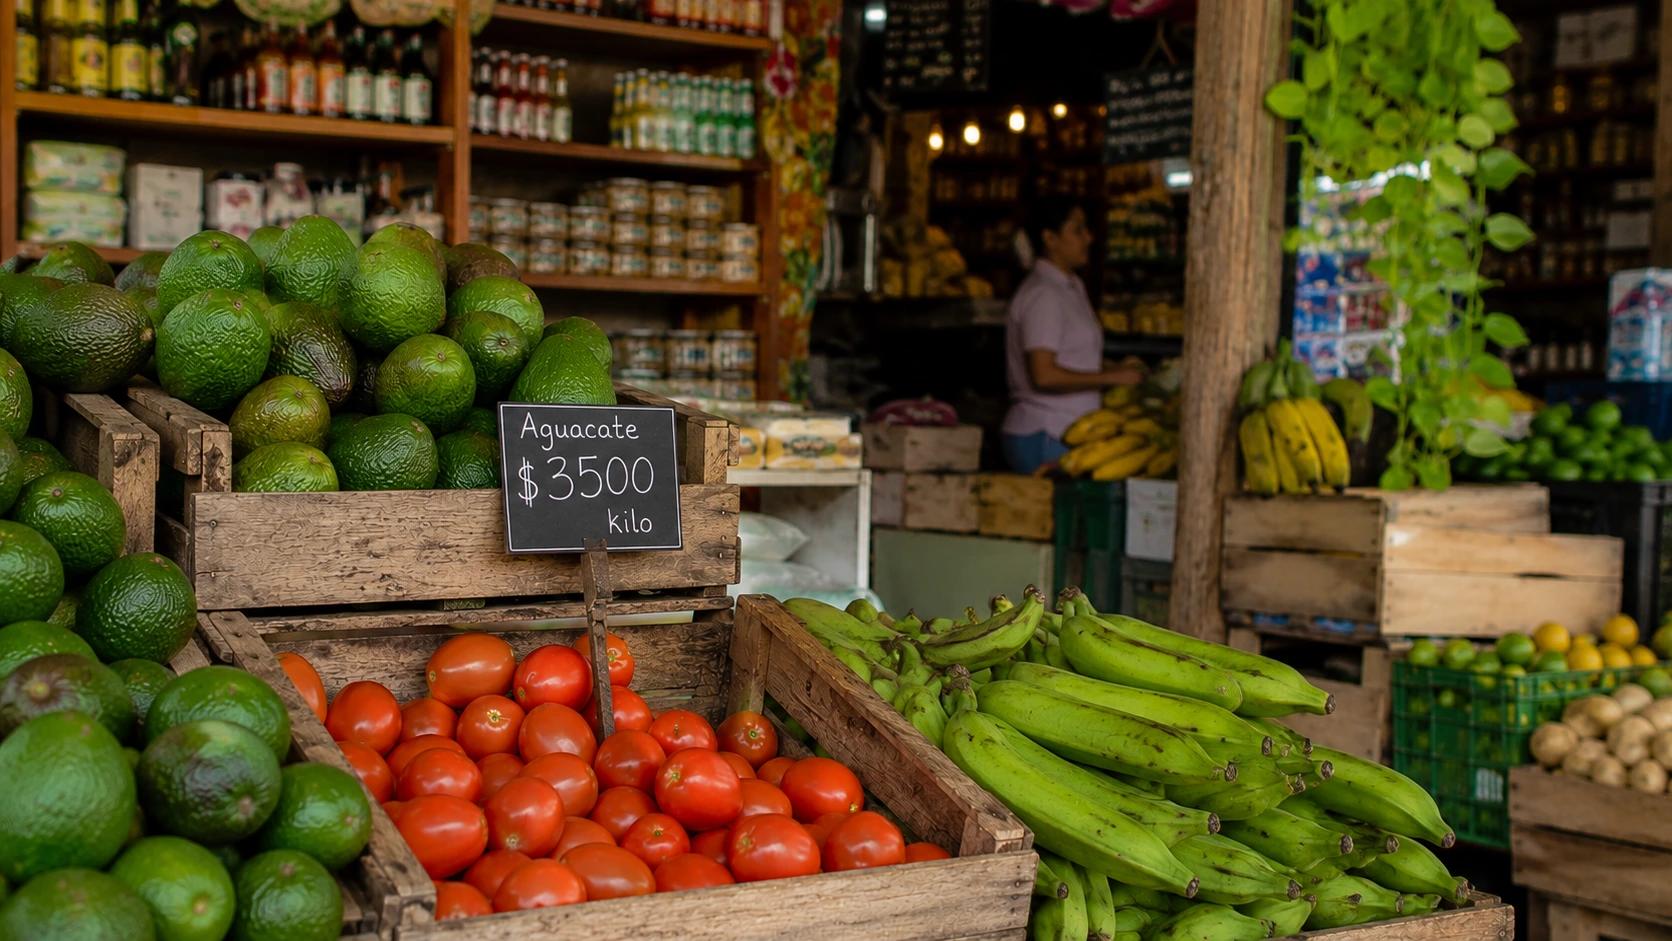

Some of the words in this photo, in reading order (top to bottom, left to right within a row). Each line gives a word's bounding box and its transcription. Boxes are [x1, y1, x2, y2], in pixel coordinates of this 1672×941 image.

[520, 411, 640, 451] Aguacate
[518, 455, 654, 508] $3500
[607, 507, 653, 534] kilo
